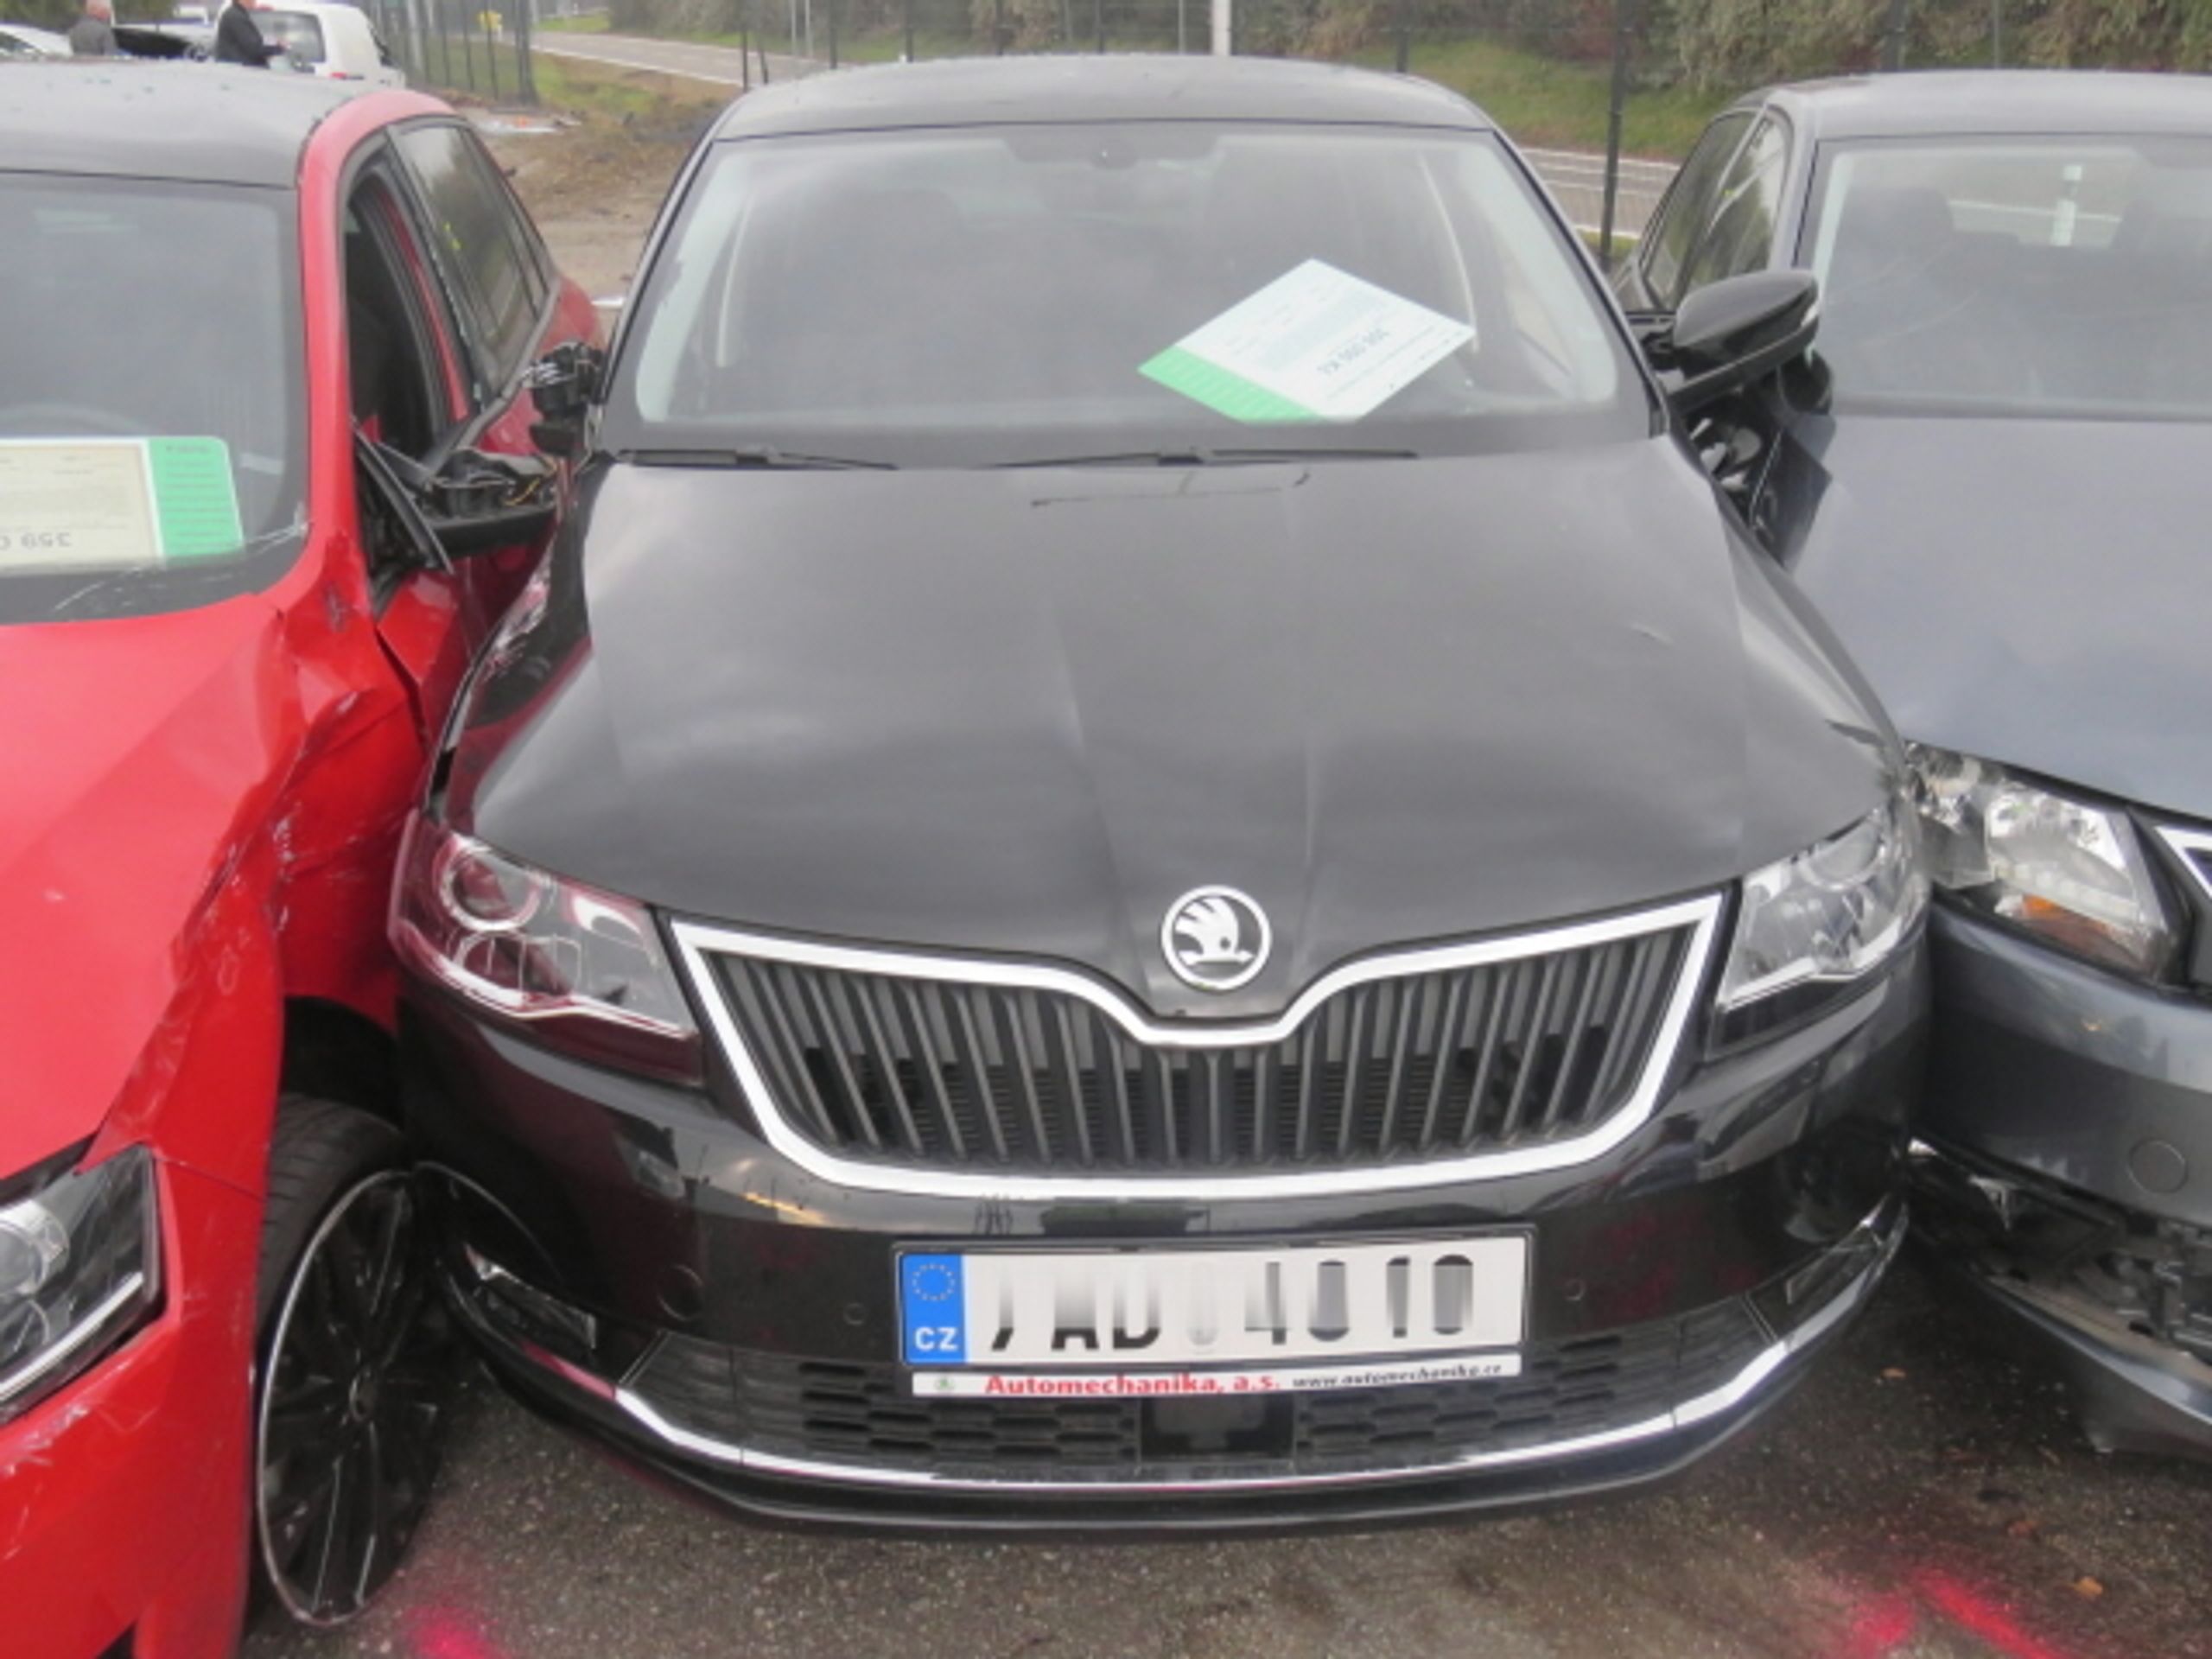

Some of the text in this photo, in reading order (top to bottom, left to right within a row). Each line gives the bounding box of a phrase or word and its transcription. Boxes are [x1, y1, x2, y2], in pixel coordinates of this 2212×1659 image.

[915, 1326, 958, 1351] CZ
[986, 1373, 1280, 1395] Automechanika, a.s.
